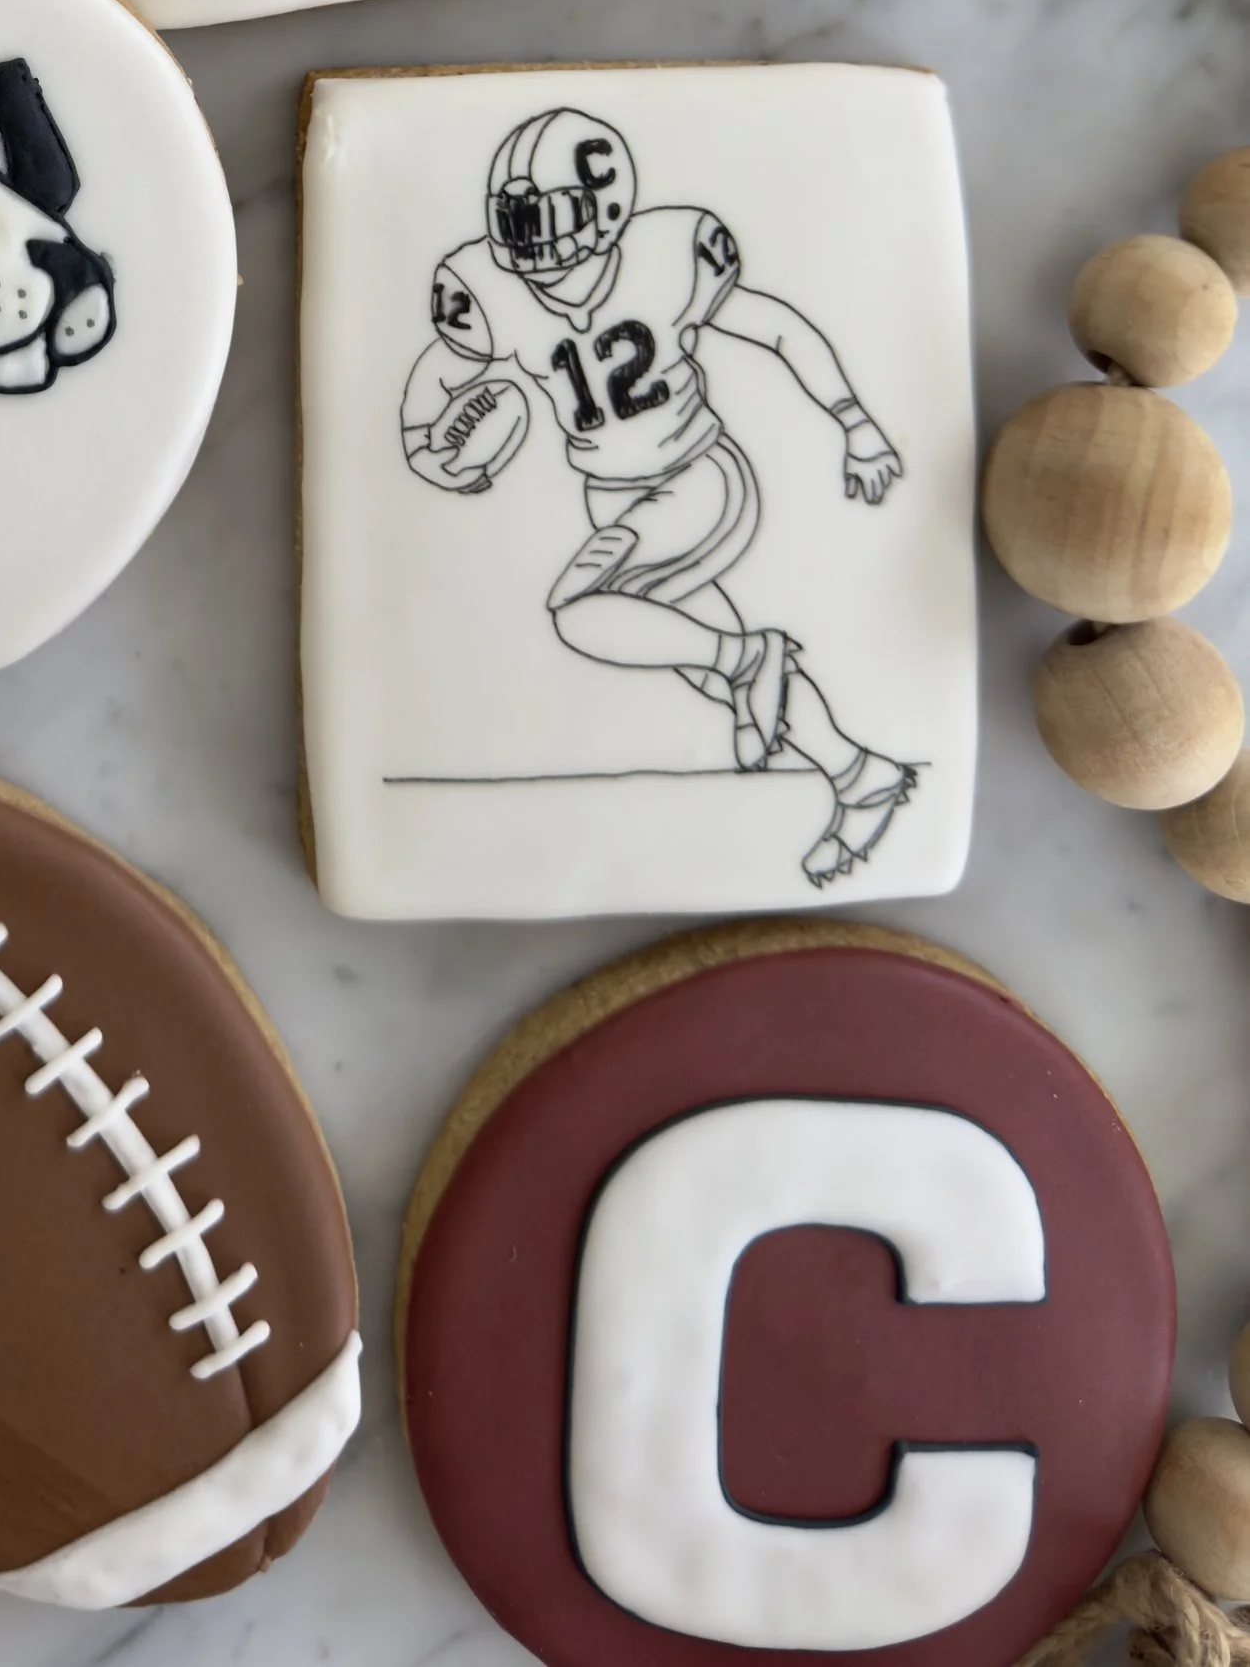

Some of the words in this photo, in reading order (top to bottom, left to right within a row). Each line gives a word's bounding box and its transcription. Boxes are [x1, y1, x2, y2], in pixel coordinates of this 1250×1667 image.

[573, 138, 616, 189] C
[696, 226, 739, 277] 12
[431, 283, 472, 330] 12
[551, 320, 670, 432] 12
[561, 1094, 1048, 1652] C
